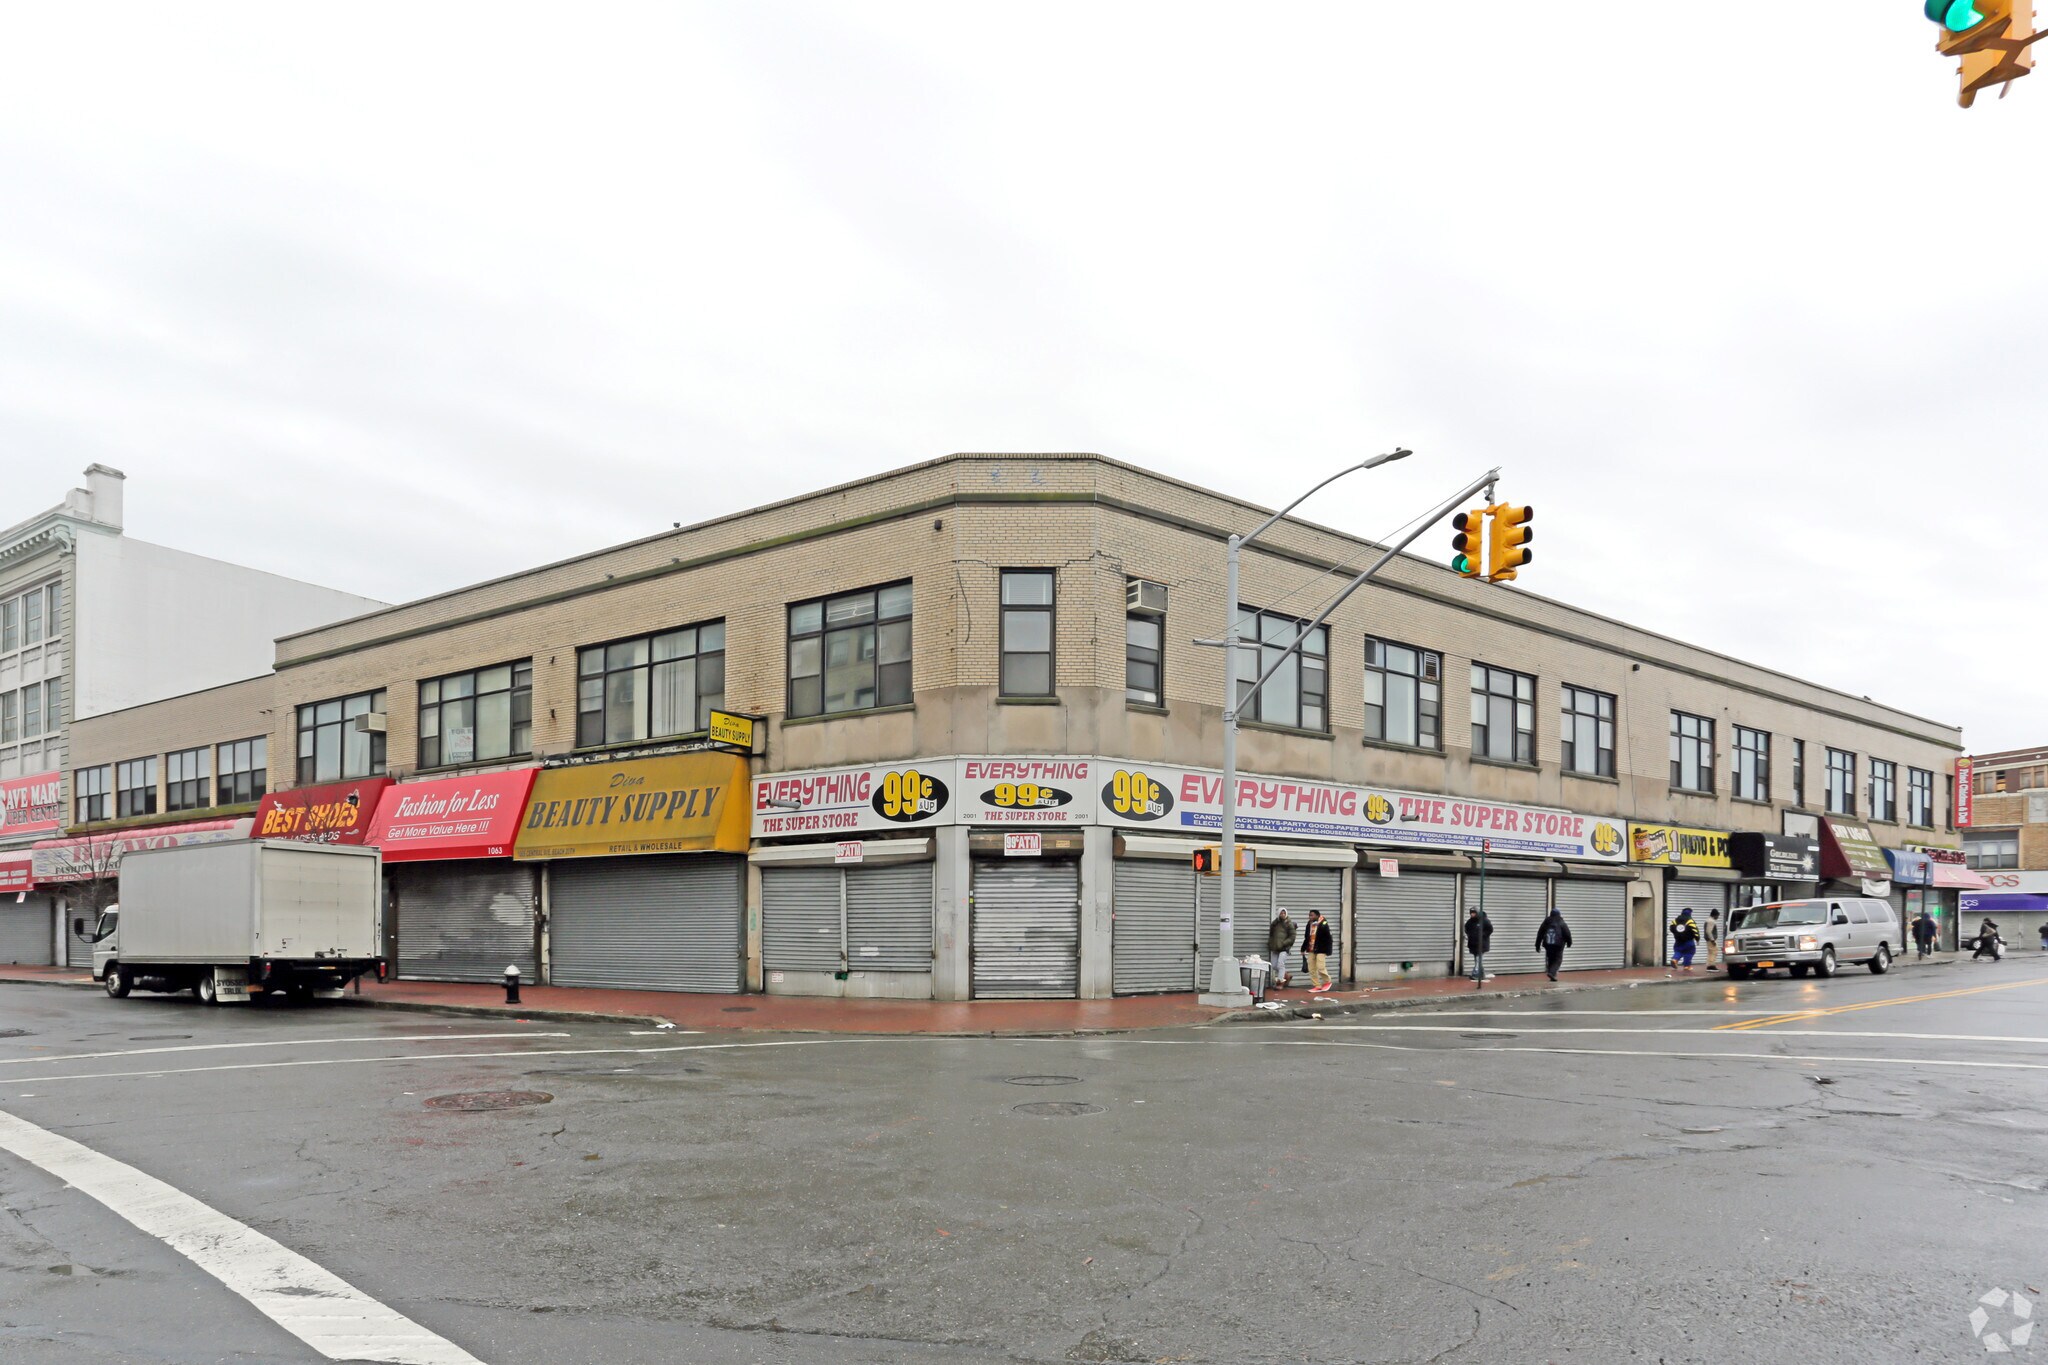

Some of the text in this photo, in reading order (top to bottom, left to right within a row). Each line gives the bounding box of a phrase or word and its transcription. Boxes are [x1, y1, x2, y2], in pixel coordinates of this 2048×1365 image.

[711, 725, 751, 743] BEAUTY SUPPLY
[965, 763, 1088, 779] EVERYTHING
[610, 773, 646, 788] Diva
[757, 772, 870, 810] EVERYTHING
[394, 789, 500, 819] Fashion for Less
[526, 787, 720, 829] BEAUTY SUPPLY
[261, 801, 359, 834] BEST SHOES
[763, 812, 859, 832] THE SUPER STORE
[985, 812, 1068, 820] THE SUPER STORE
[1399, 797, 1585, 838] THE SUPER STORE
[388, 829, 403, 839] Get
[405, 827, 427, 837] More
[429, 824, 454, 835] Value
[454, 823, 477, 833] Here
[1253, 824, 1276, 832] SMALL
[488, 847, 503, 855] 1063
[609, 844, 631, 852] RETAIL
[640, 842, 682, 851] WHOLESALE
[1680, 834, 1707, 856] PHOTO
[1710, 837, 1715, 856] &
